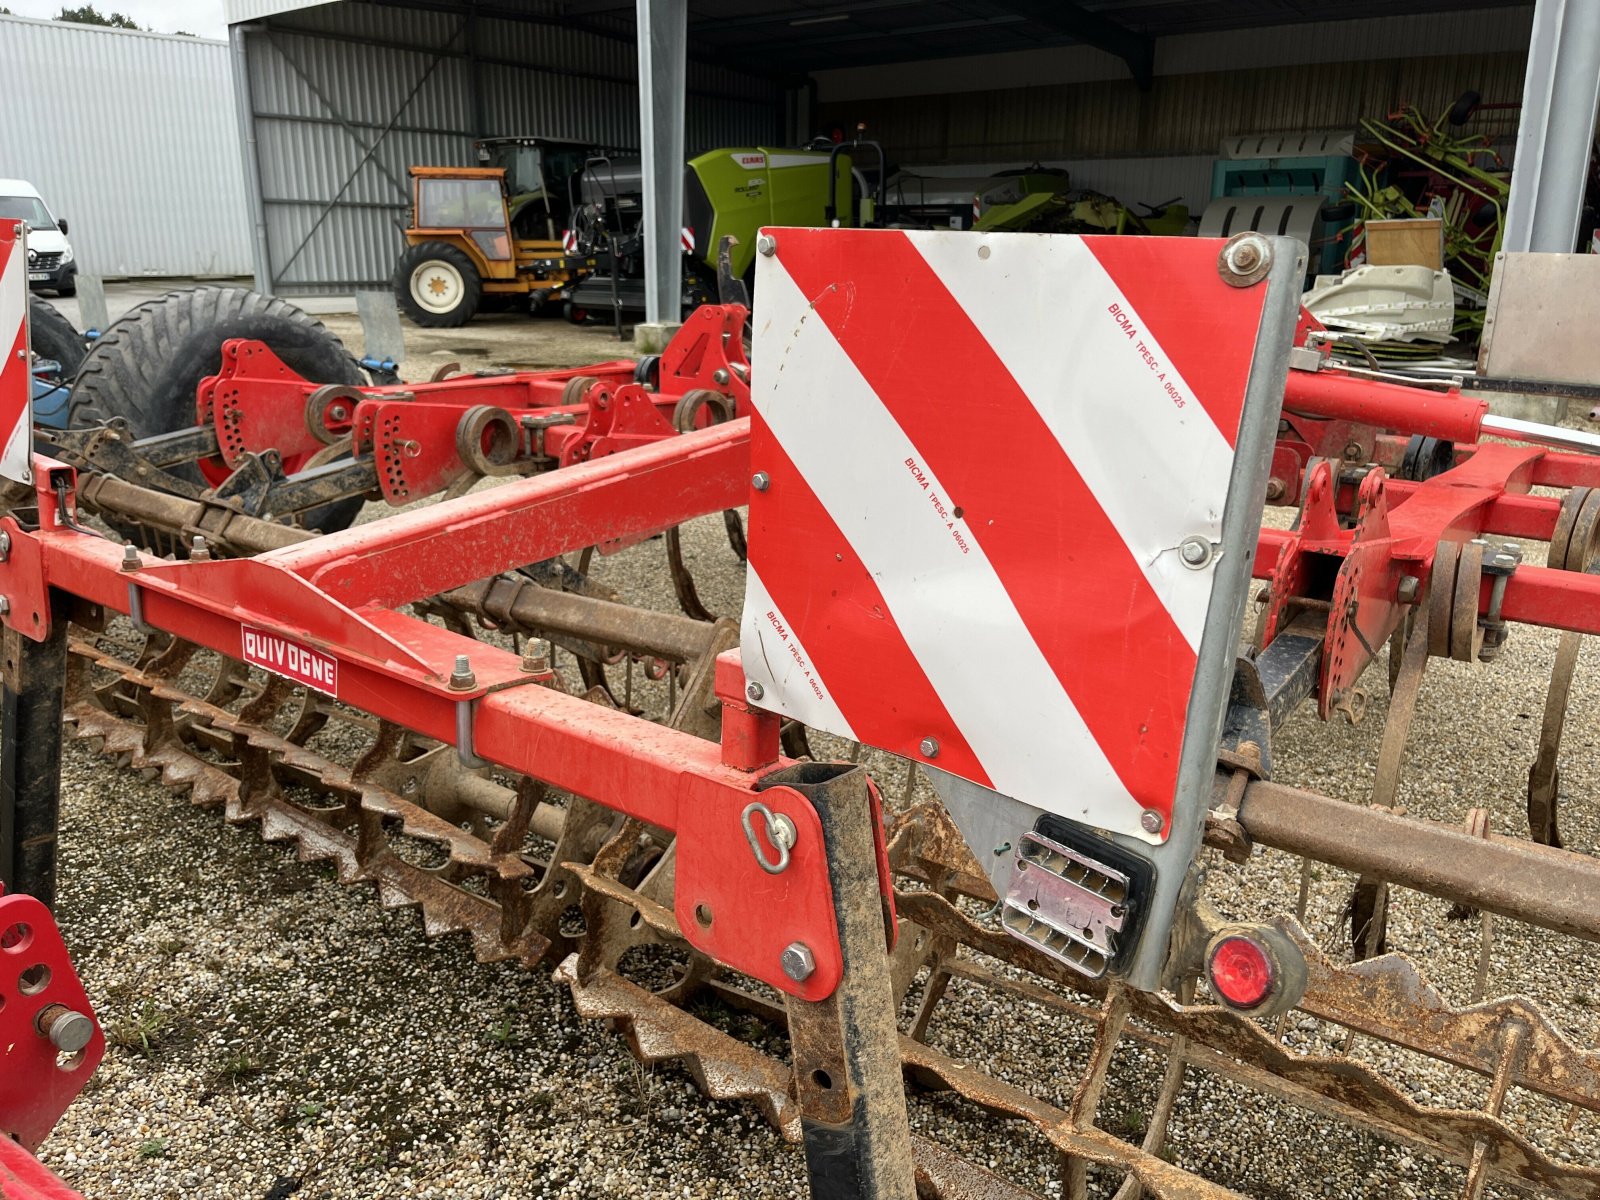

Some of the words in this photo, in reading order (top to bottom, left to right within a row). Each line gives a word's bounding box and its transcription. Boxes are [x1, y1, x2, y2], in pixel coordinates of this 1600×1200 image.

[742, 156, 764, 164] CLAAS
[1108, 303, 1137, 340] BICMA
[1164, 382, 1186, 408] 06025
[904, 457, 929, 490] BICMA
[952, 530, 970, 554] 06025
[245, 632, 334, 685] QUIVOGNE
[766, 611, 789, 641] BICMA
[809, 678, 824, 700] 06025
